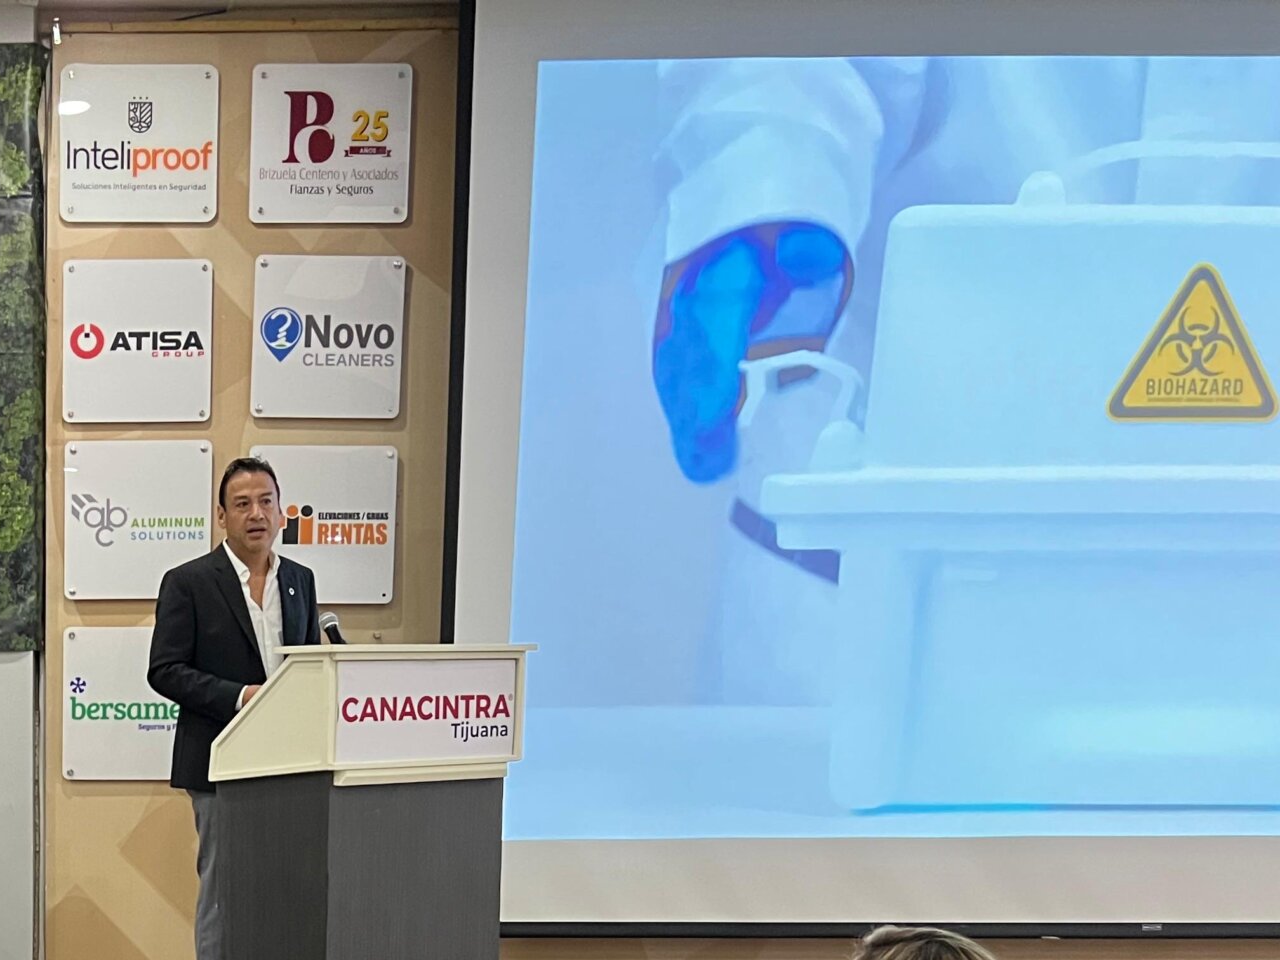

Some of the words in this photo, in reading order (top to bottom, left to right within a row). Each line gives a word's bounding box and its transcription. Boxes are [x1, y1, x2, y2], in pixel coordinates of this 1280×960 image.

[351, 110, 389, 143] 25
[66, 140, 213, 177] Inteliproof
[259, 167, 297, 180] Brizuela
[300, 167, 340, 180] Centeno
[342, 171, 348, 181] y
[351, 168, 399, 180] Asociados
[72, 182, 112, 190] Soluciones
[113, 182, 157, 191] Inteligentes
[169, 183, 207, 192] Seguridad
[327, 186, 332, 196] y
[336, 184, 374, 196] Seguros
[110, 331, 204, 351] ATISA
[304, 314, 395, 350] Novo
[303, 353, 395, 367] CLEANERS
[1146, 378, 1244, 396] BIOHAZARD
[131, 517, 205, 528] ALUMINUM
[130, 531, 204, 541] SOLUTIONS
[317, 523, 388, 545] RENTAS
[341, 694, 510, 723] CANACINTRA
[138, 723, 165, 731] Seguros
[451, 723, 508, 742] Tijuana
